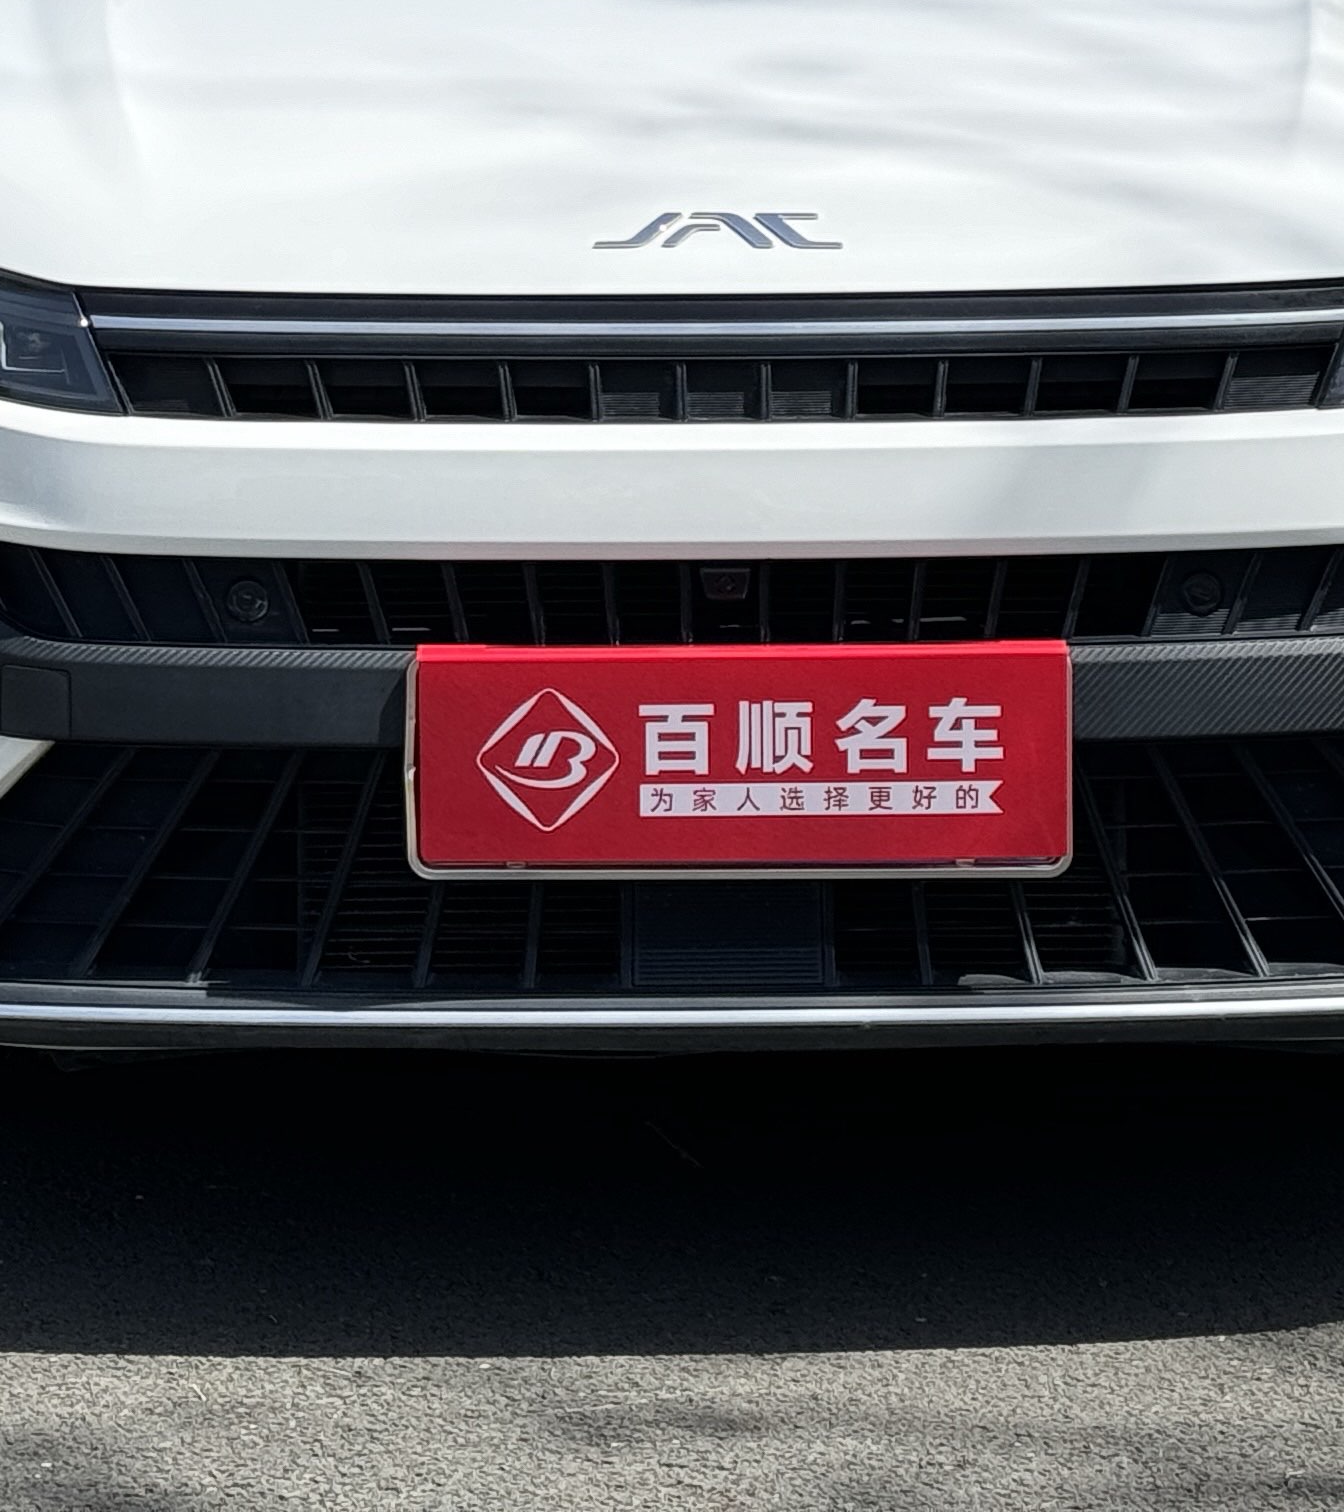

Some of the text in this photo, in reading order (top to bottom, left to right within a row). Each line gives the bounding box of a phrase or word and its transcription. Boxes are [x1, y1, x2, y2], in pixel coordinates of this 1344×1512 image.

[592, 212, 843, 249] JAC
[638, 697, 1004, 776] 百顺名车
[649, 784, 980, 812] 为家人选择更好的
